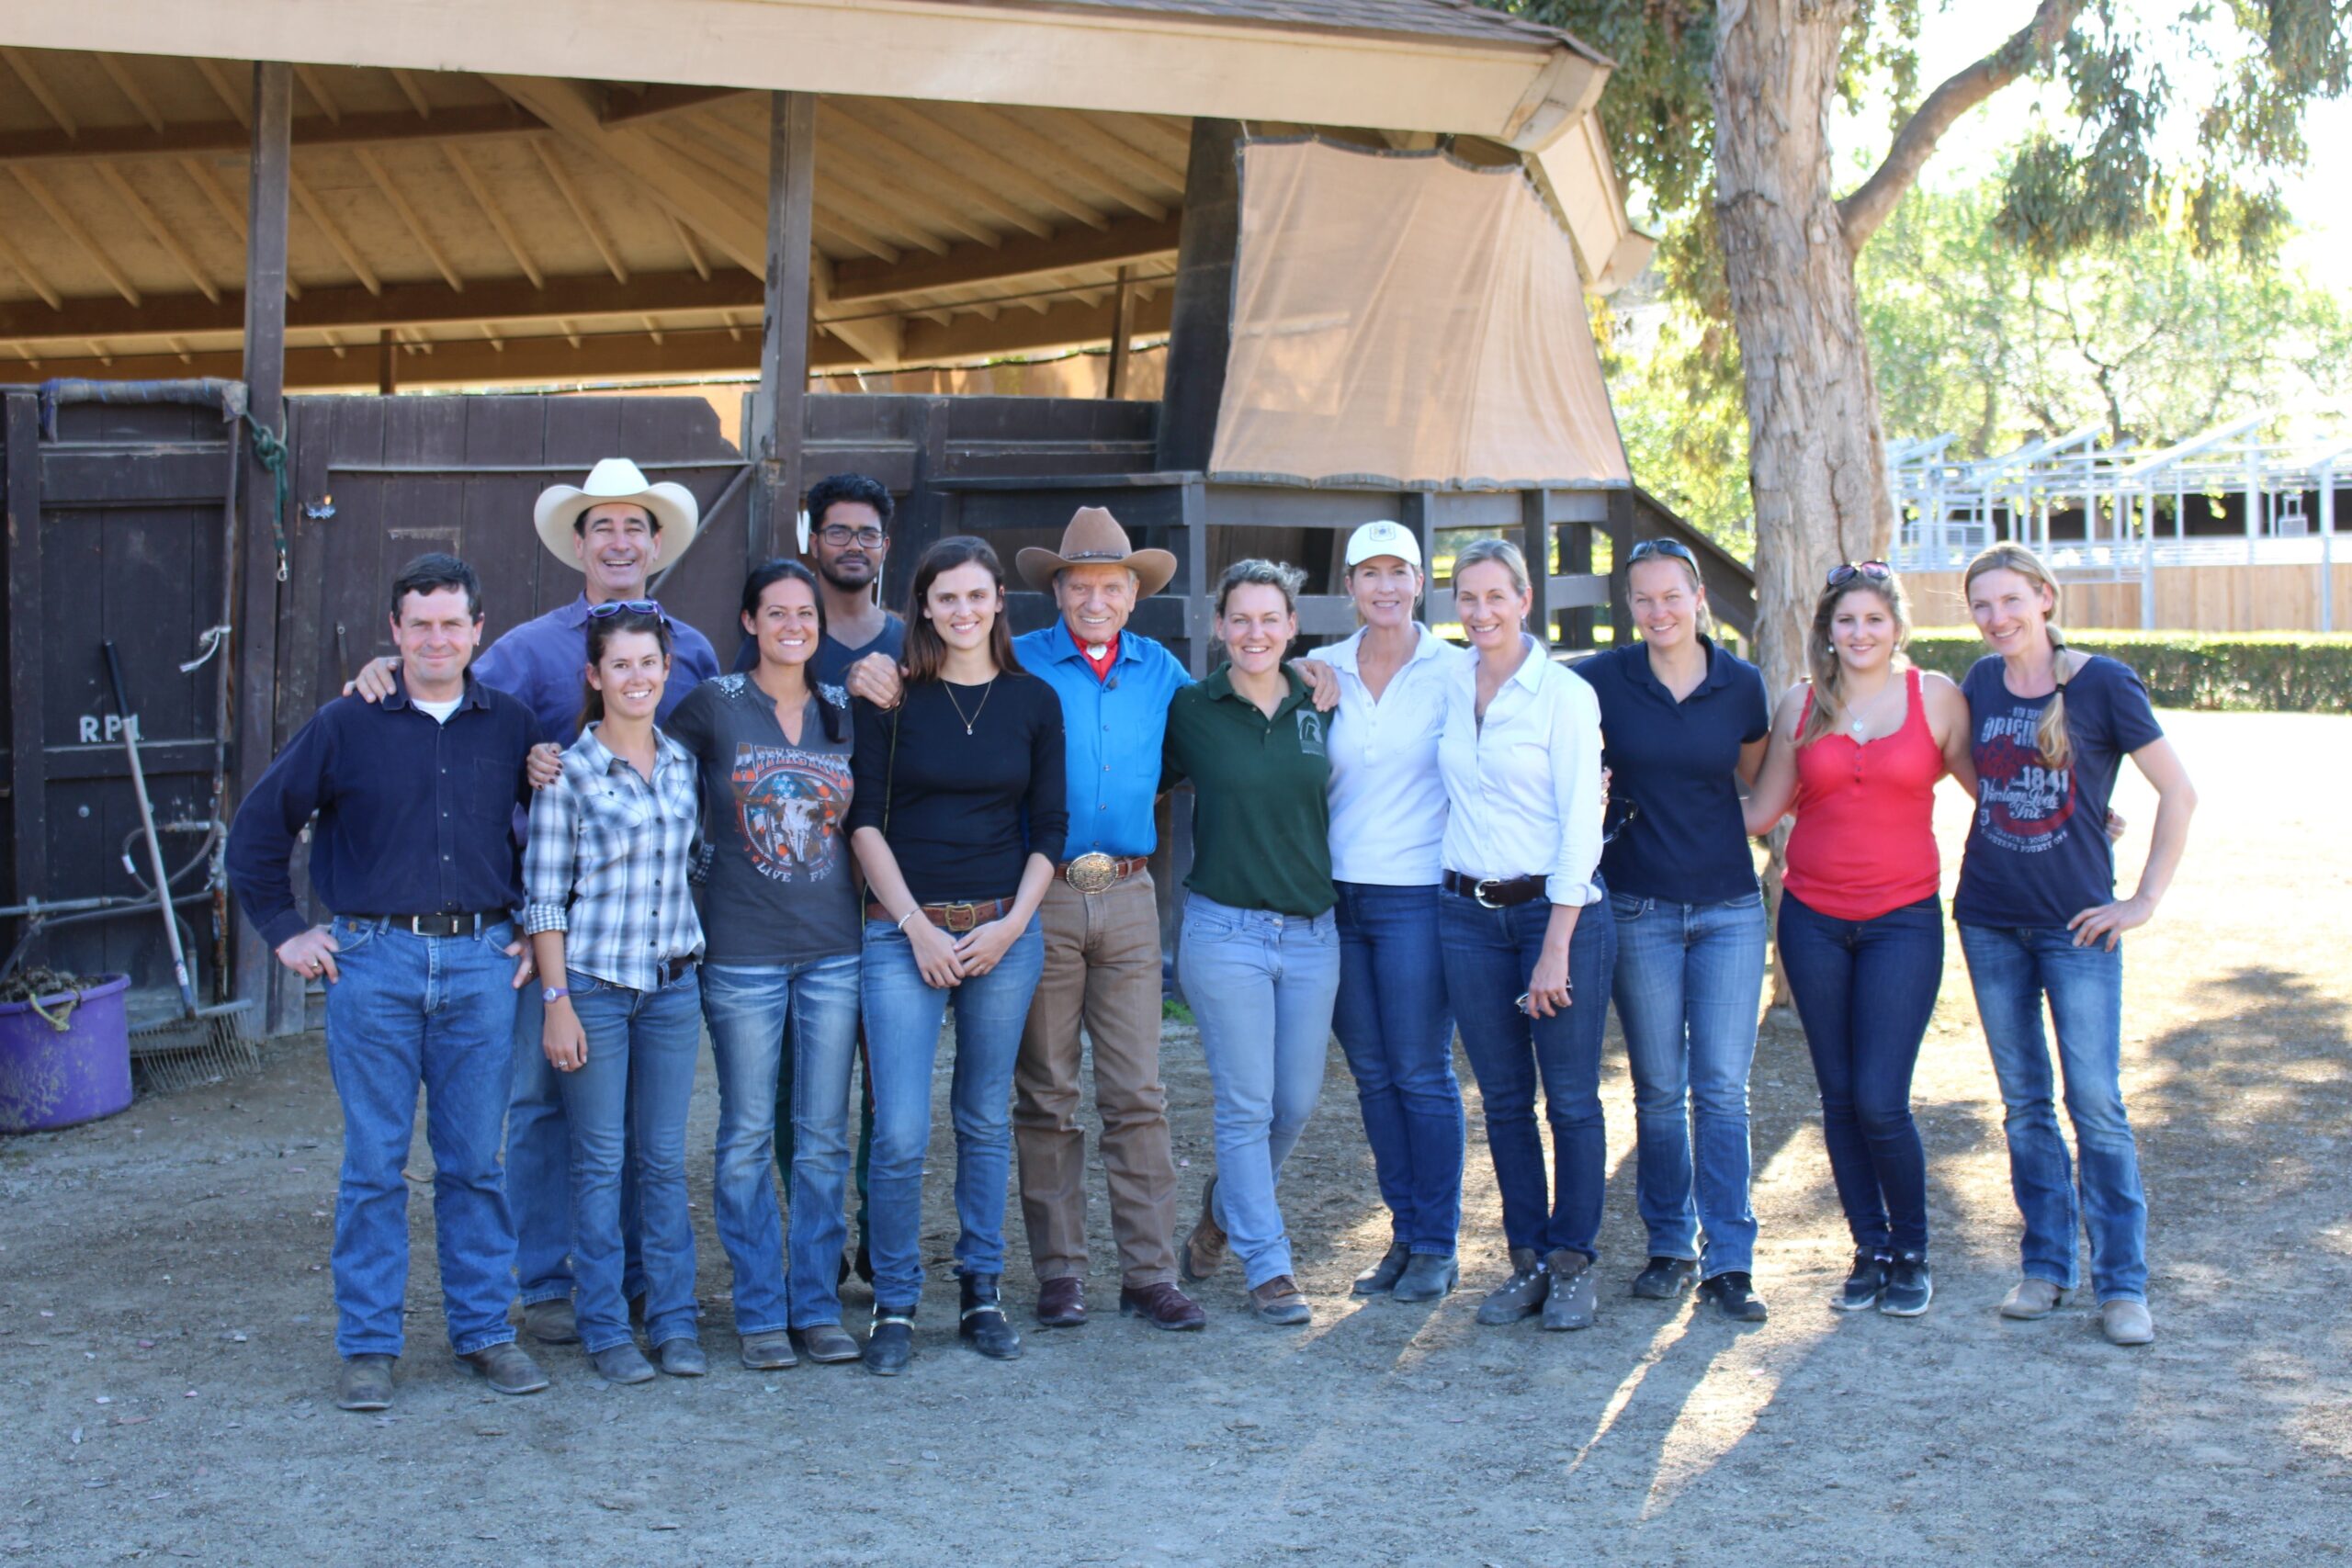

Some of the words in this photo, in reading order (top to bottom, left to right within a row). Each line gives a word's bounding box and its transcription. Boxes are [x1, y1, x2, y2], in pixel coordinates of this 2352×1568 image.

[1981, 716, 2040, 748] ORIGIN
[2022, 765, 2069, 793] 1841
[756, 862, 792, 883] LIVE
